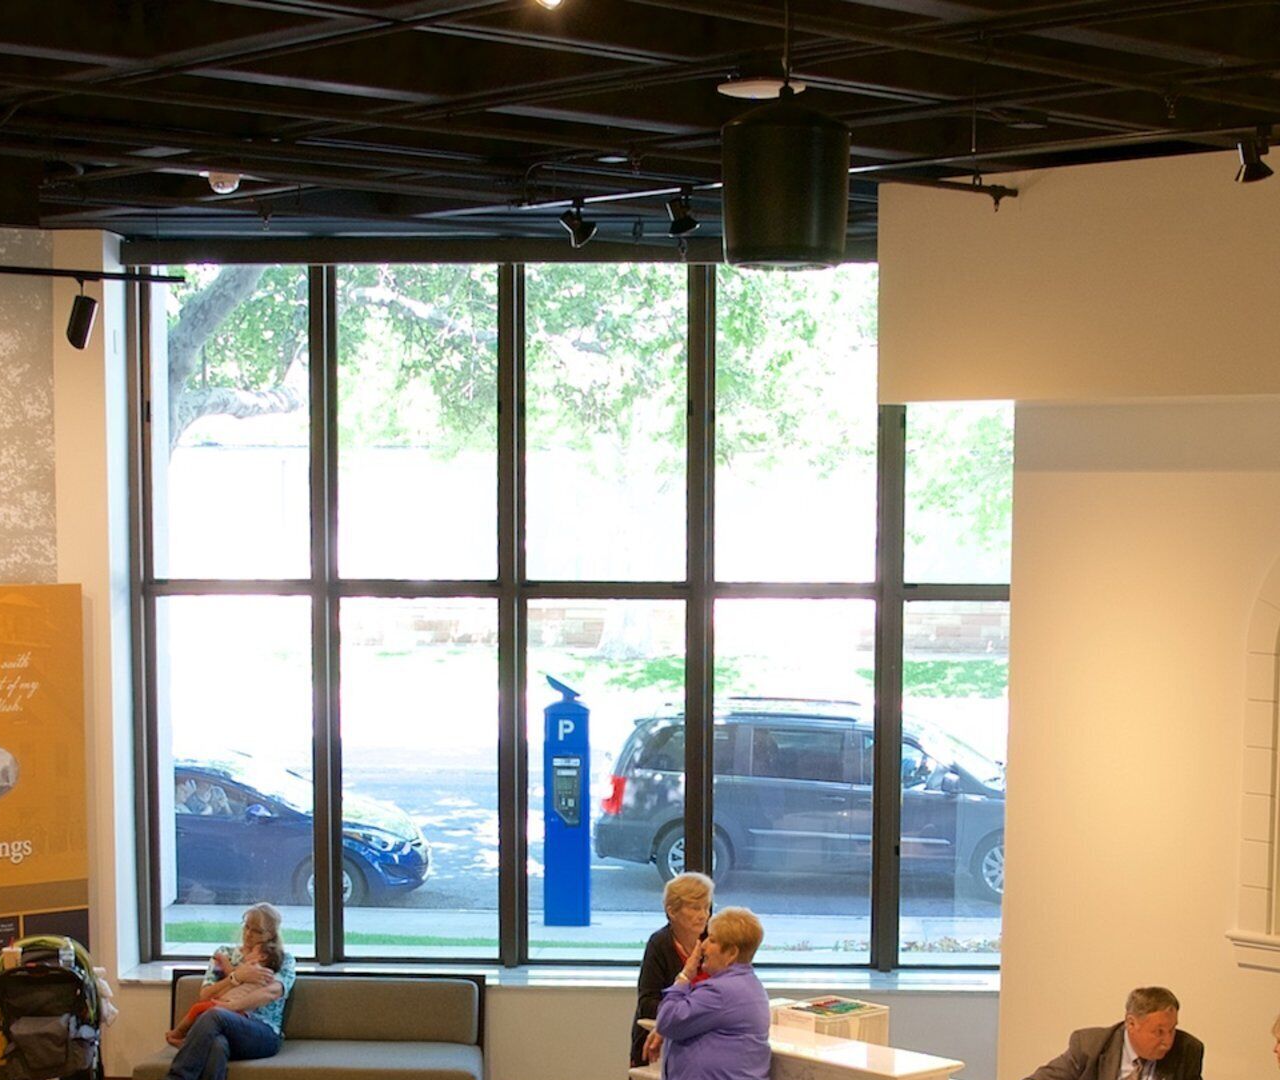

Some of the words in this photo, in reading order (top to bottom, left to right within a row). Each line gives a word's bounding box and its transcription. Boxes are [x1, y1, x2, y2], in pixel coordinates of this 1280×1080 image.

[7, 676, 21, 698] of
[20, 681, 39, 699] my
[558, 719, 575, 741] P
